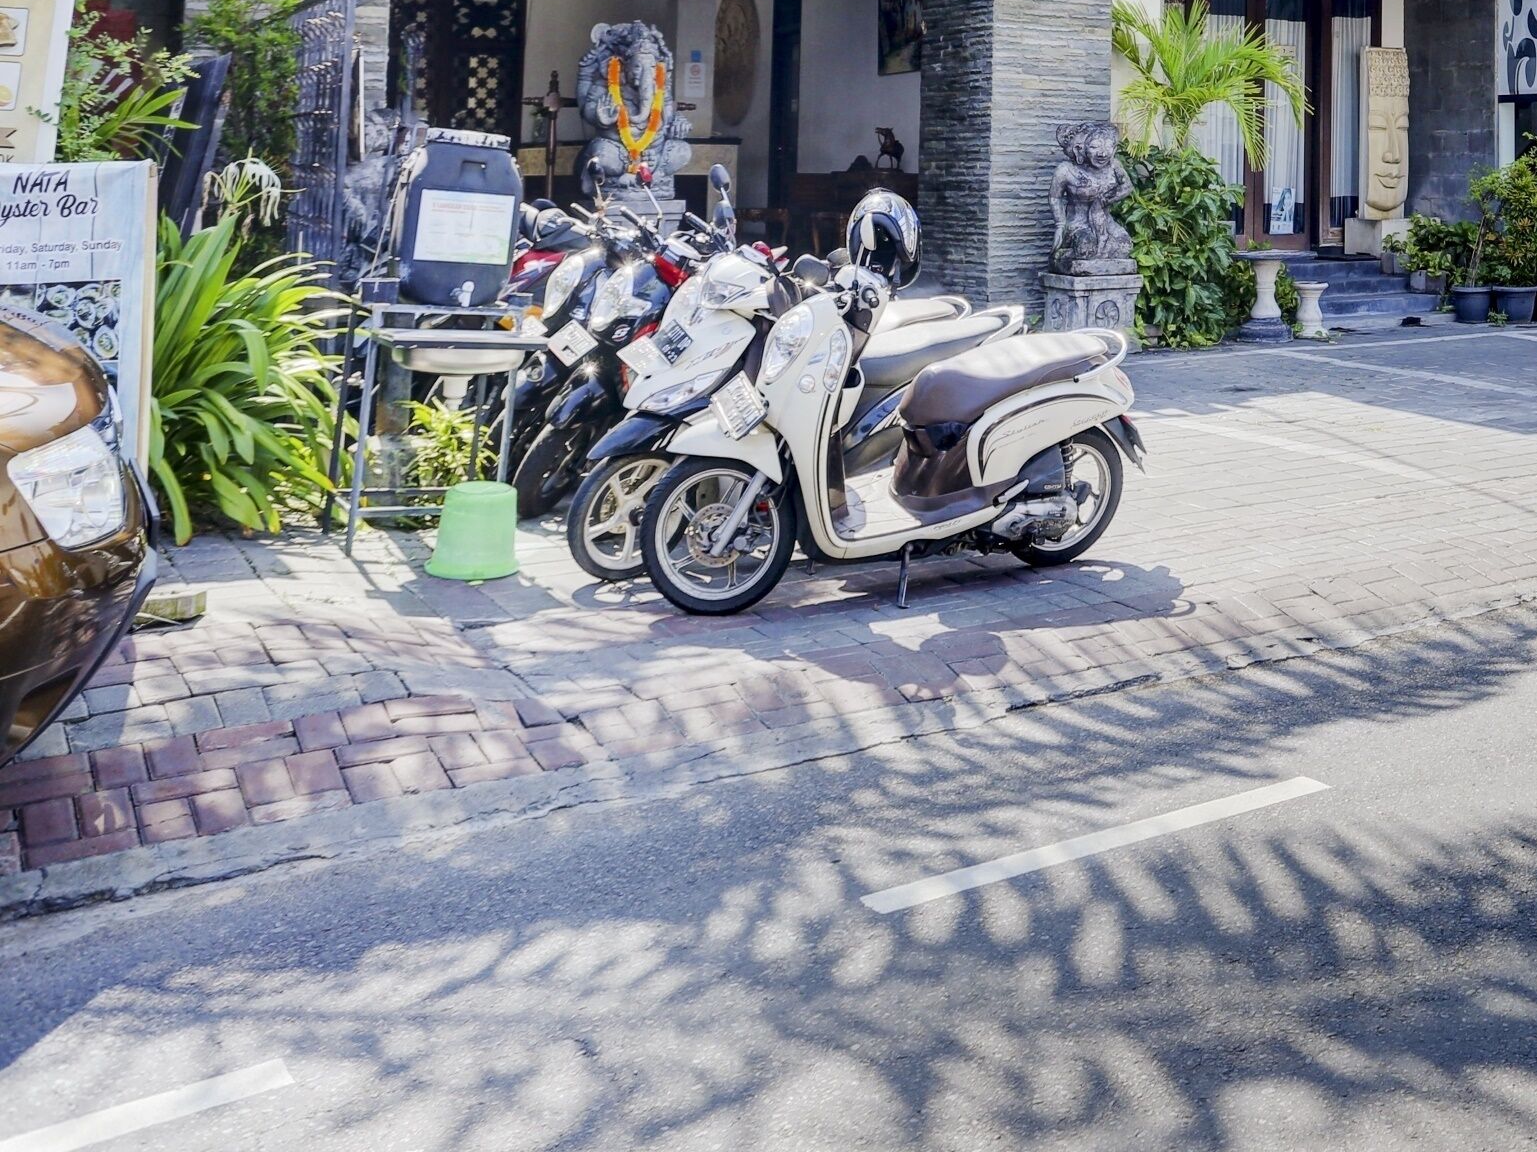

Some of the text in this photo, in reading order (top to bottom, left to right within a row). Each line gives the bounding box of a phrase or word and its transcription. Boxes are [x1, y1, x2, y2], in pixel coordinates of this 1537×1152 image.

[13, 169, 71, 195] NATA
[0, 194, 98, 229] yster Bar
[31, 242, 78, 254] Saturday,
[81, 239, 122, 252] Sunday
[6, 260, 37, 271] 11am
[48, 259, 70, 270] 7pm
